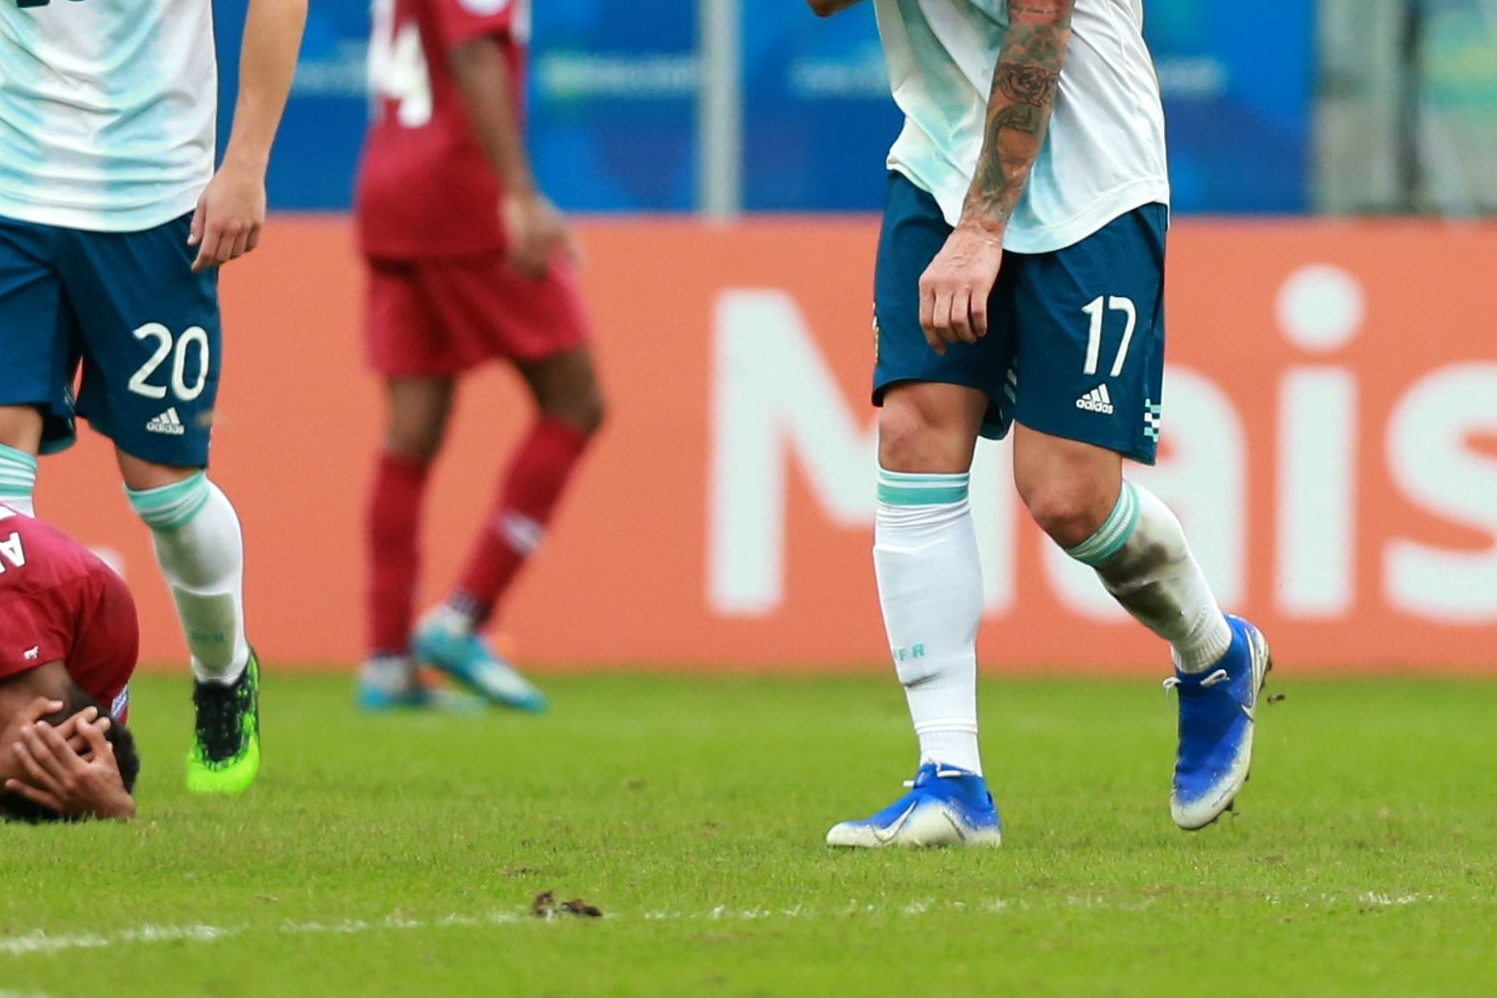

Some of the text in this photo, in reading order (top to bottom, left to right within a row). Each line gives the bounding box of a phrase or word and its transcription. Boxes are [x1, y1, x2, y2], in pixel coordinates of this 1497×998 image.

[1080, 295, 1137, 377] 17
[127, 322, 210, 401] 20
[146, 421, 185, 435] adidas
[1075, 398, 1114, 415] adidas
